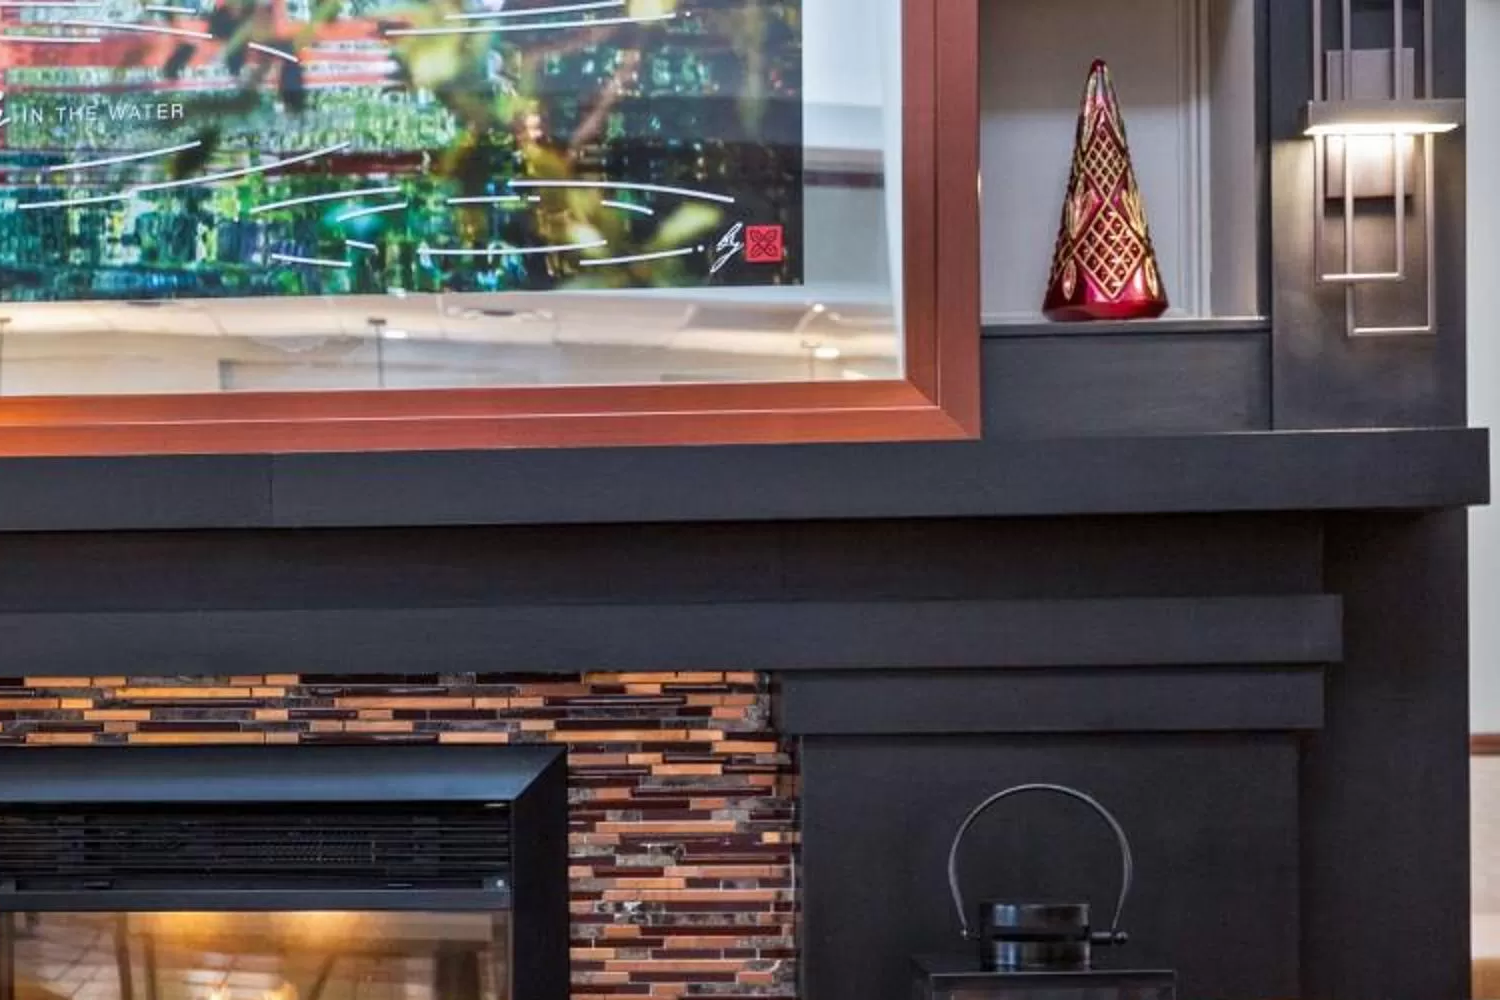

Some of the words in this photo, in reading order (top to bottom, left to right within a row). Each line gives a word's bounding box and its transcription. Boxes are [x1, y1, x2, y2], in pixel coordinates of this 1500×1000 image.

[22, 106, 43, 123] IN
[56, 106, 97, 121] THE
[107, 103, 185, 120] WATER
